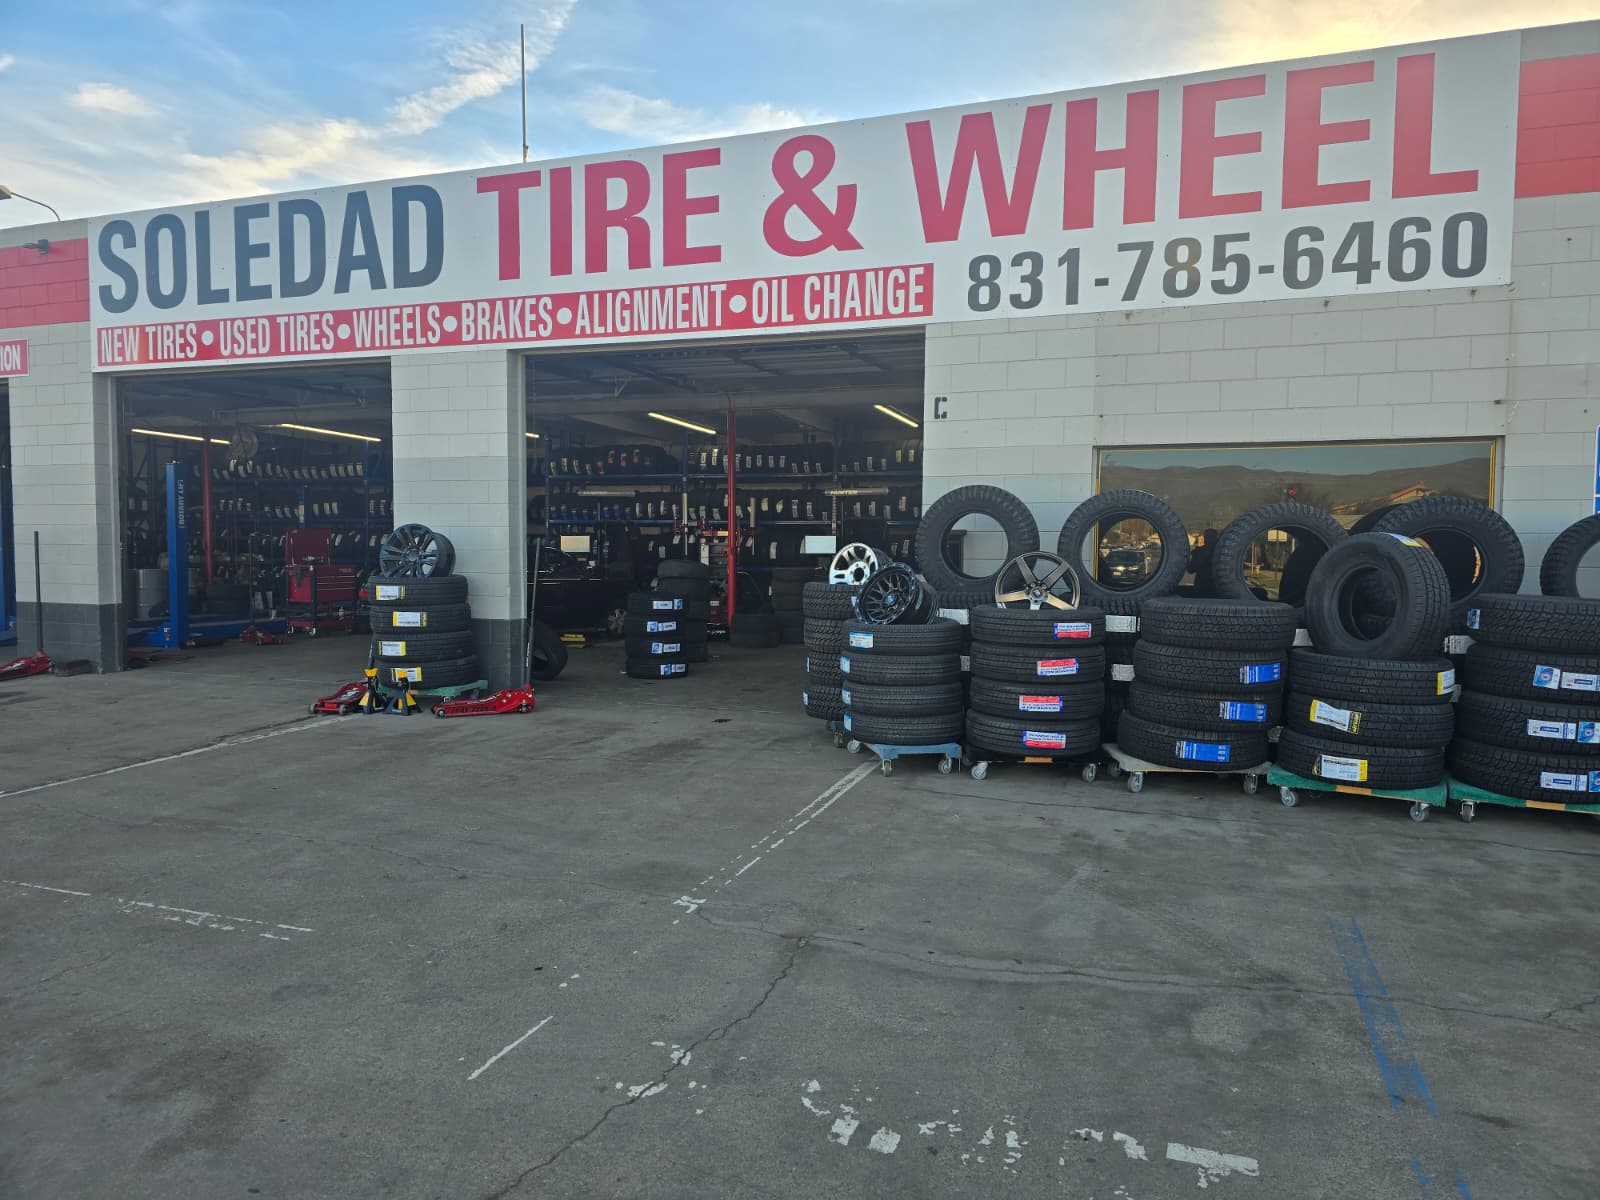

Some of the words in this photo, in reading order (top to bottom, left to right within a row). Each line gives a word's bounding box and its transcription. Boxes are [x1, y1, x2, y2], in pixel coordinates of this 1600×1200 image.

[97, 185, 445, 313] SOLEDAD
[476, 148, 721, 280] TIRE
[762, 134, 864, 257] &
[905, 52, 1479, 243] WHEEL
[967, 211, 1488, 312] 831-785-6460
[100, 327, 140, 364] NEW
[145, 322, 198, 362] TIRES
[219, 317, 270, 357] USED
[276, 312, 335, 353] TIRES
[352, 304, 441, 348] WHEELS
[461, 296, 553, 342] BRAKES
[574, 283, 728, 335] ALIGNMENT
[751, 278, 794, 324] OIL
[803, 266, 925, 321] CHANGE
